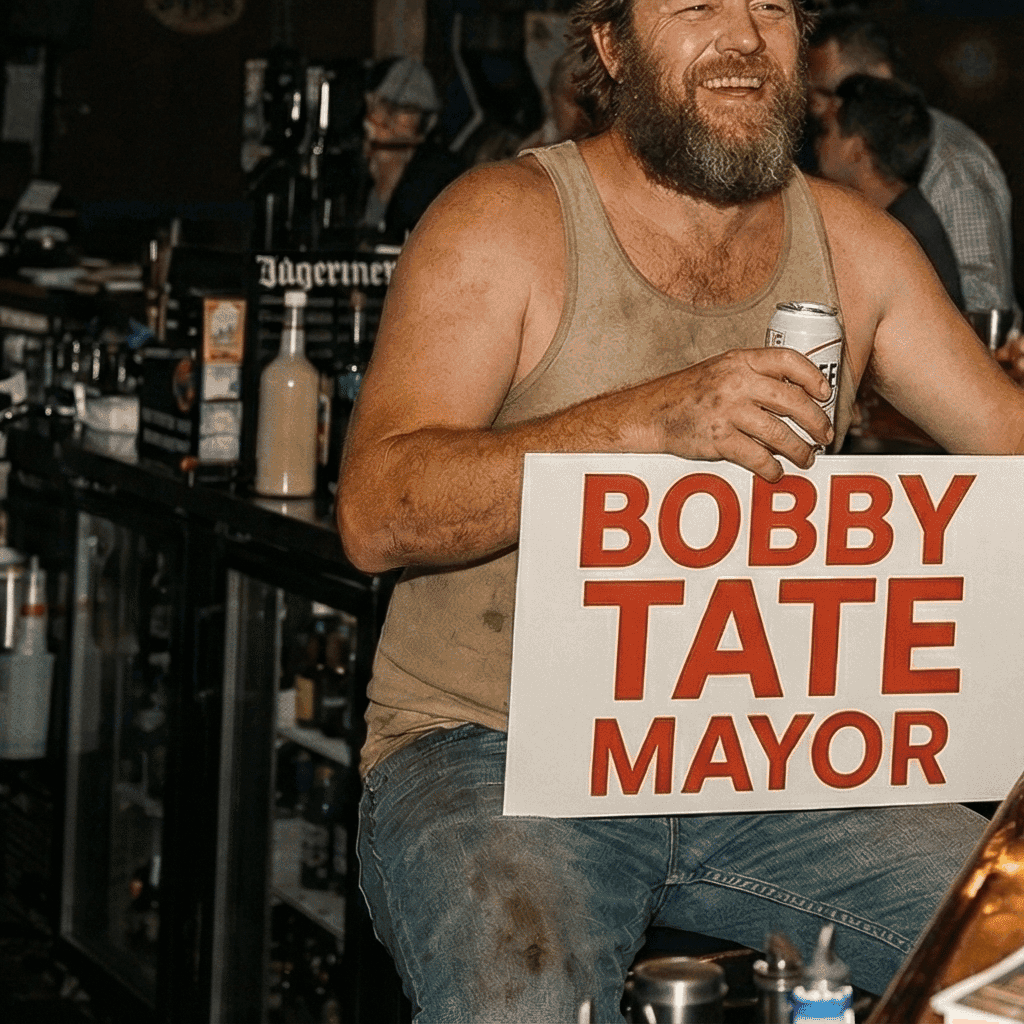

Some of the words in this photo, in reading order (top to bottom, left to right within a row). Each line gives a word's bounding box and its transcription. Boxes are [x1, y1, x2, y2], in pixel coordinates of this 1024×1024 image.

[579, 472, 977, 568] BOBBY
[583, 576, 964, 700] TATE
[590, 710, 949, 796] MAYOR
